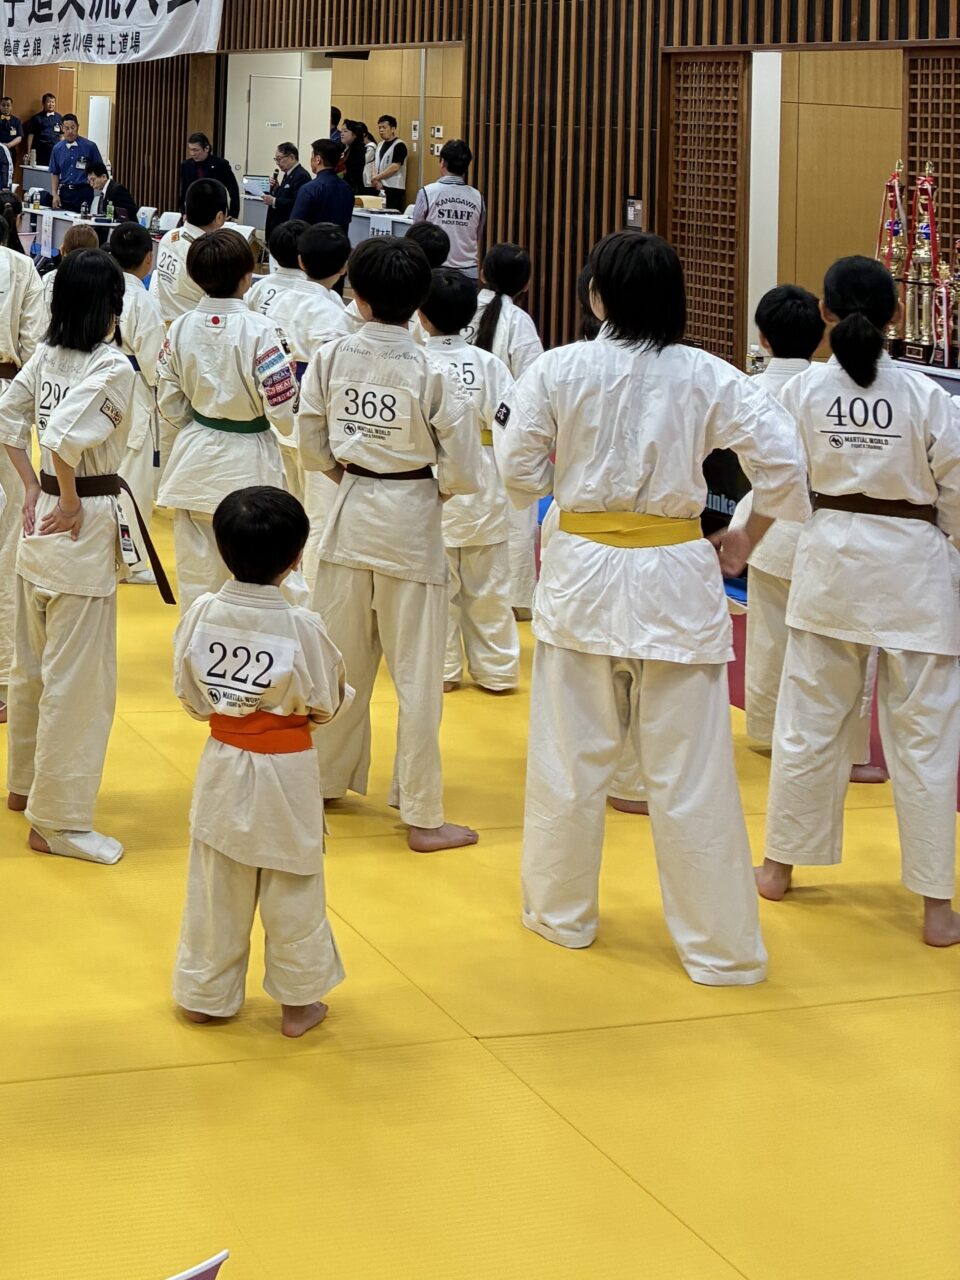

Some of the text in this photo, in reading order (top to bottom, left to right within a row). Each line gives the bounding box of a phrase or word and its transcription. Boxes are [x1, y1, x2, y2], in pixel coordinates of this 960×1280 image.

[435, 197, 476, 210] KANAGAWA
[437, 209, 473, 221] STAFF
[159, 251, 178, 275] 275
[40, 381, 70, 410] 29
[344, 388, 396, 423] 368
[826, 396, 893, 429] 400
[844, 436, 868, 444] MARTIAL
[206, 642, 274, 689] 222
[222, 691, 263, 704] MARTIAL WOR
